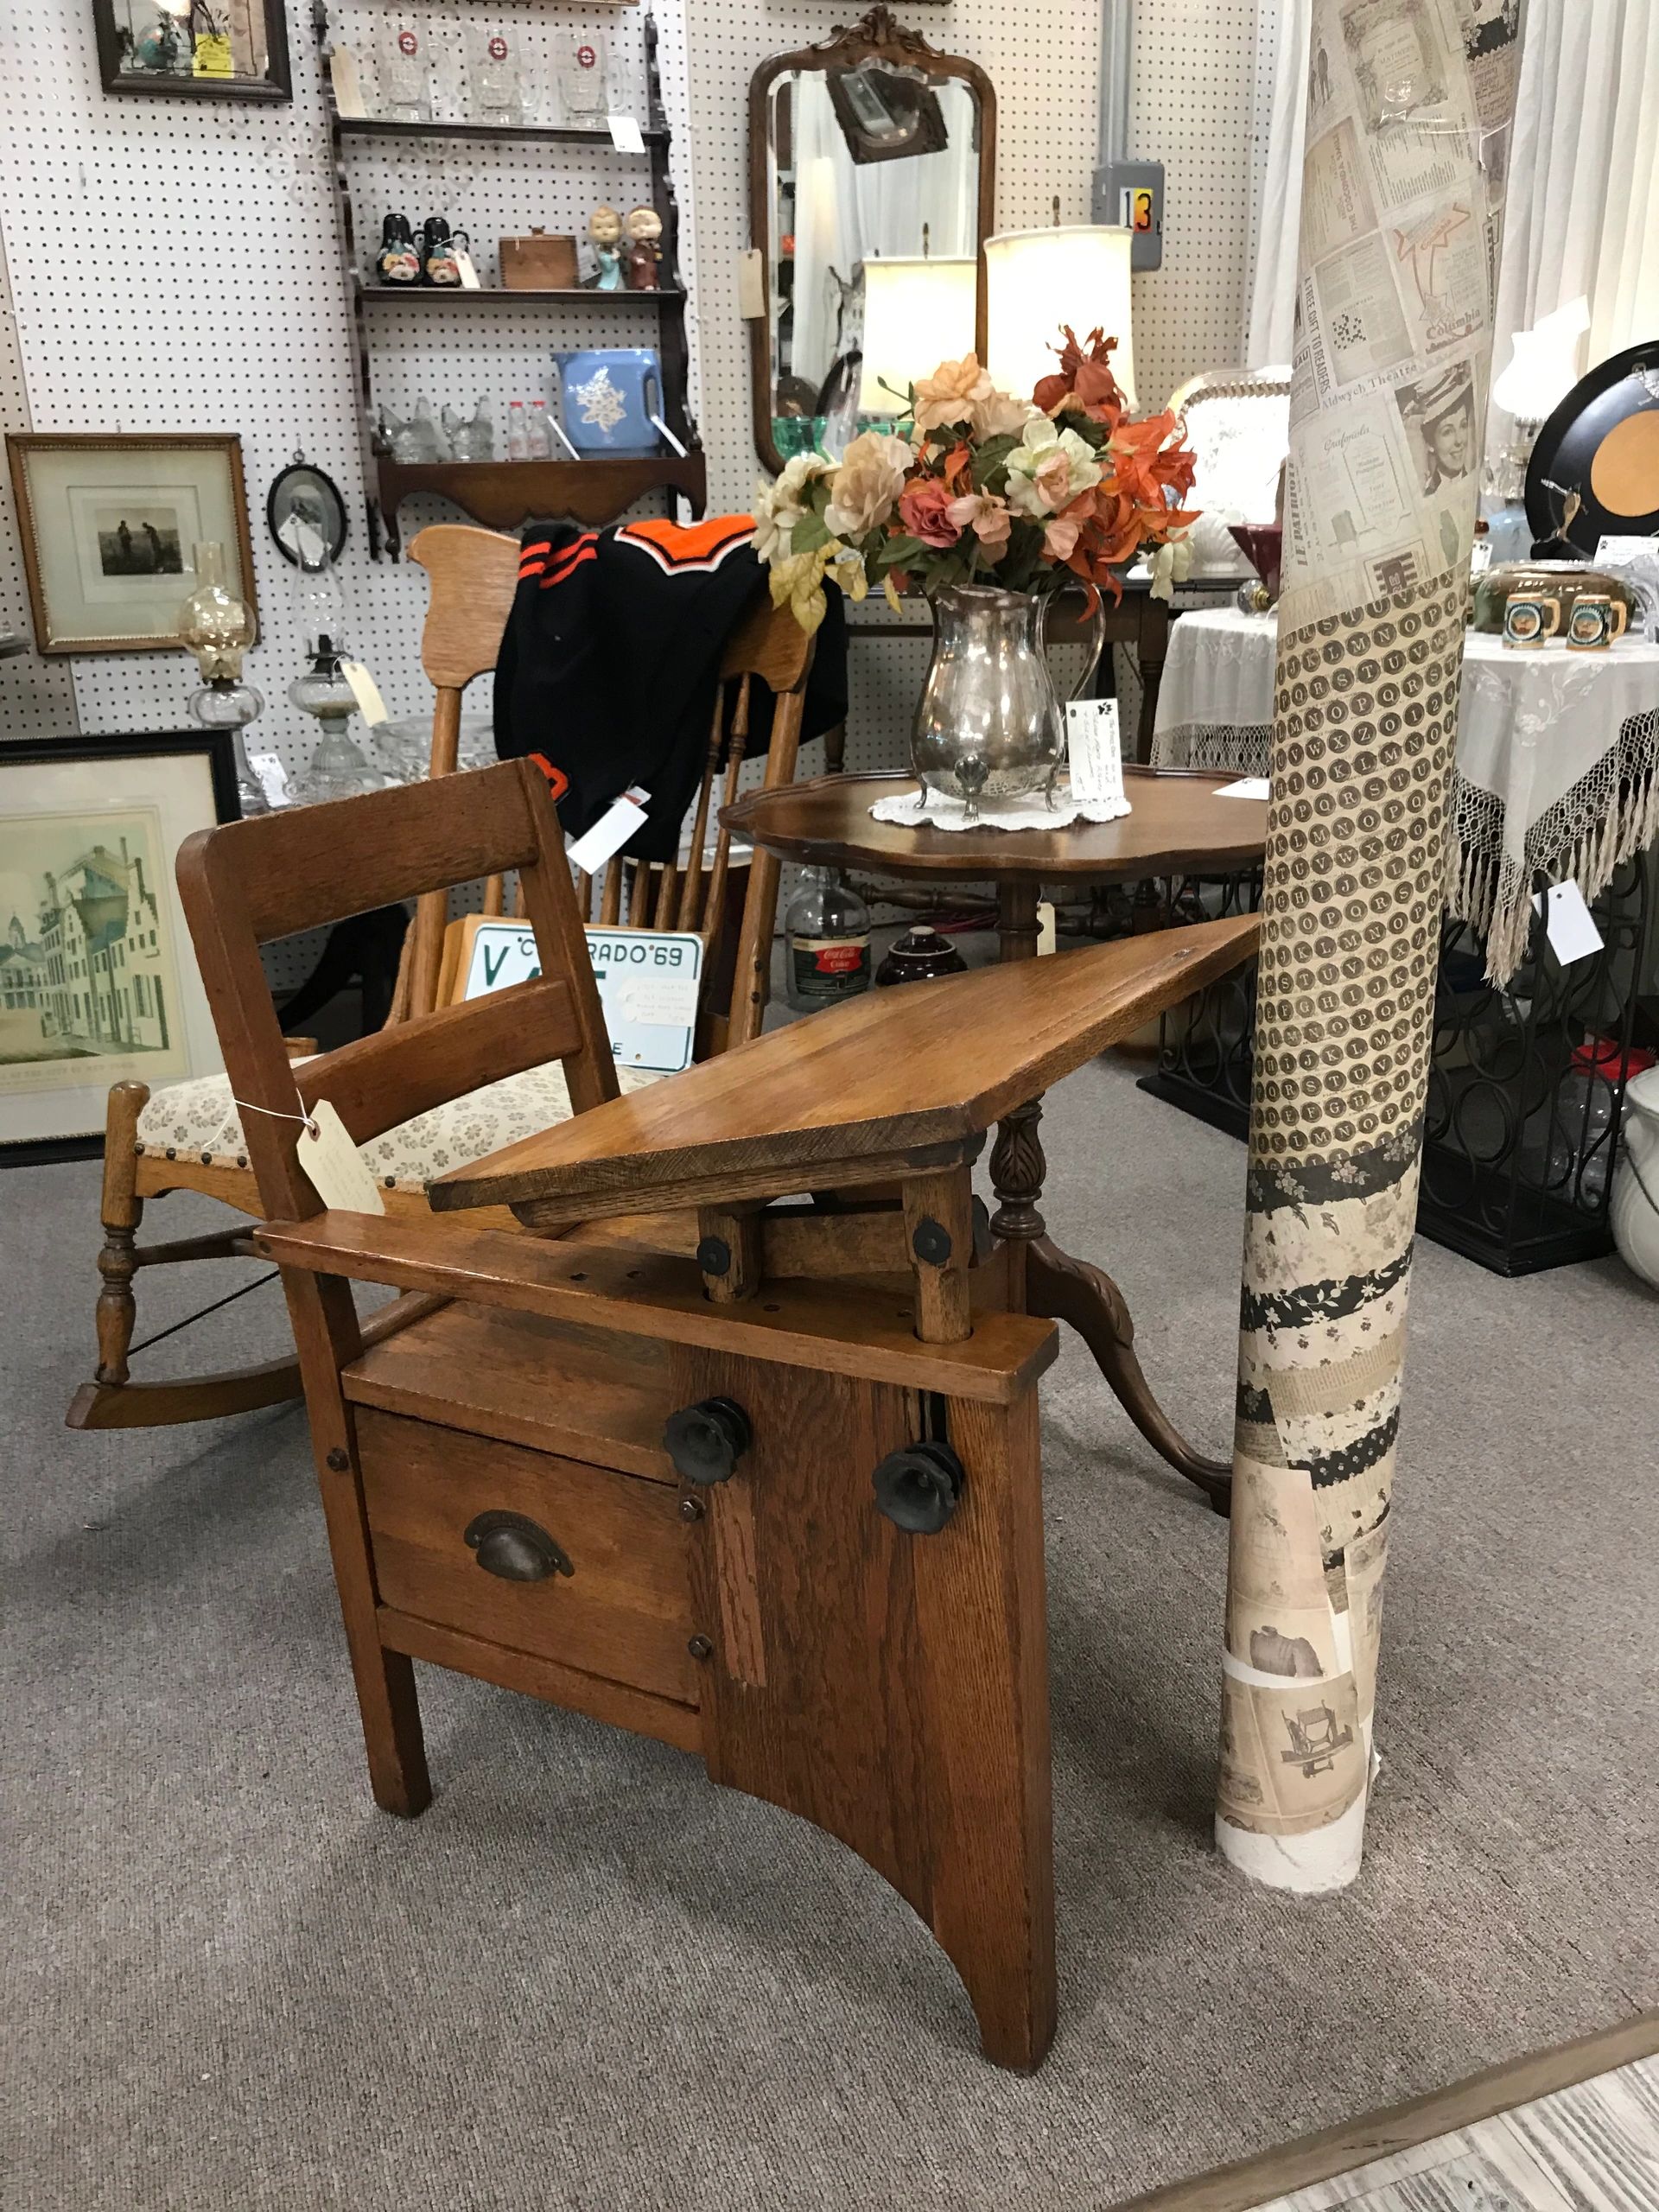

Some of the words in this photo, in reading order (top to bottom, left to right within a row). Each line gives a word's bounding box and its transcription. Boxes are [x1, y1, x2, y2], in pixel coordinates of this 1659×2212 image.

[1124, 191, 1152, 230] 13
[1306, 286, 1315, 311] FREE
[1307, 310, 1319, 334] GIFT
[1427, 308, 1480, 340] Columbia
[1312, 334, 1322, 350] TO
[1314, 348, 1331, 395] READERS
[520, 938, 646, 963] CRADO
